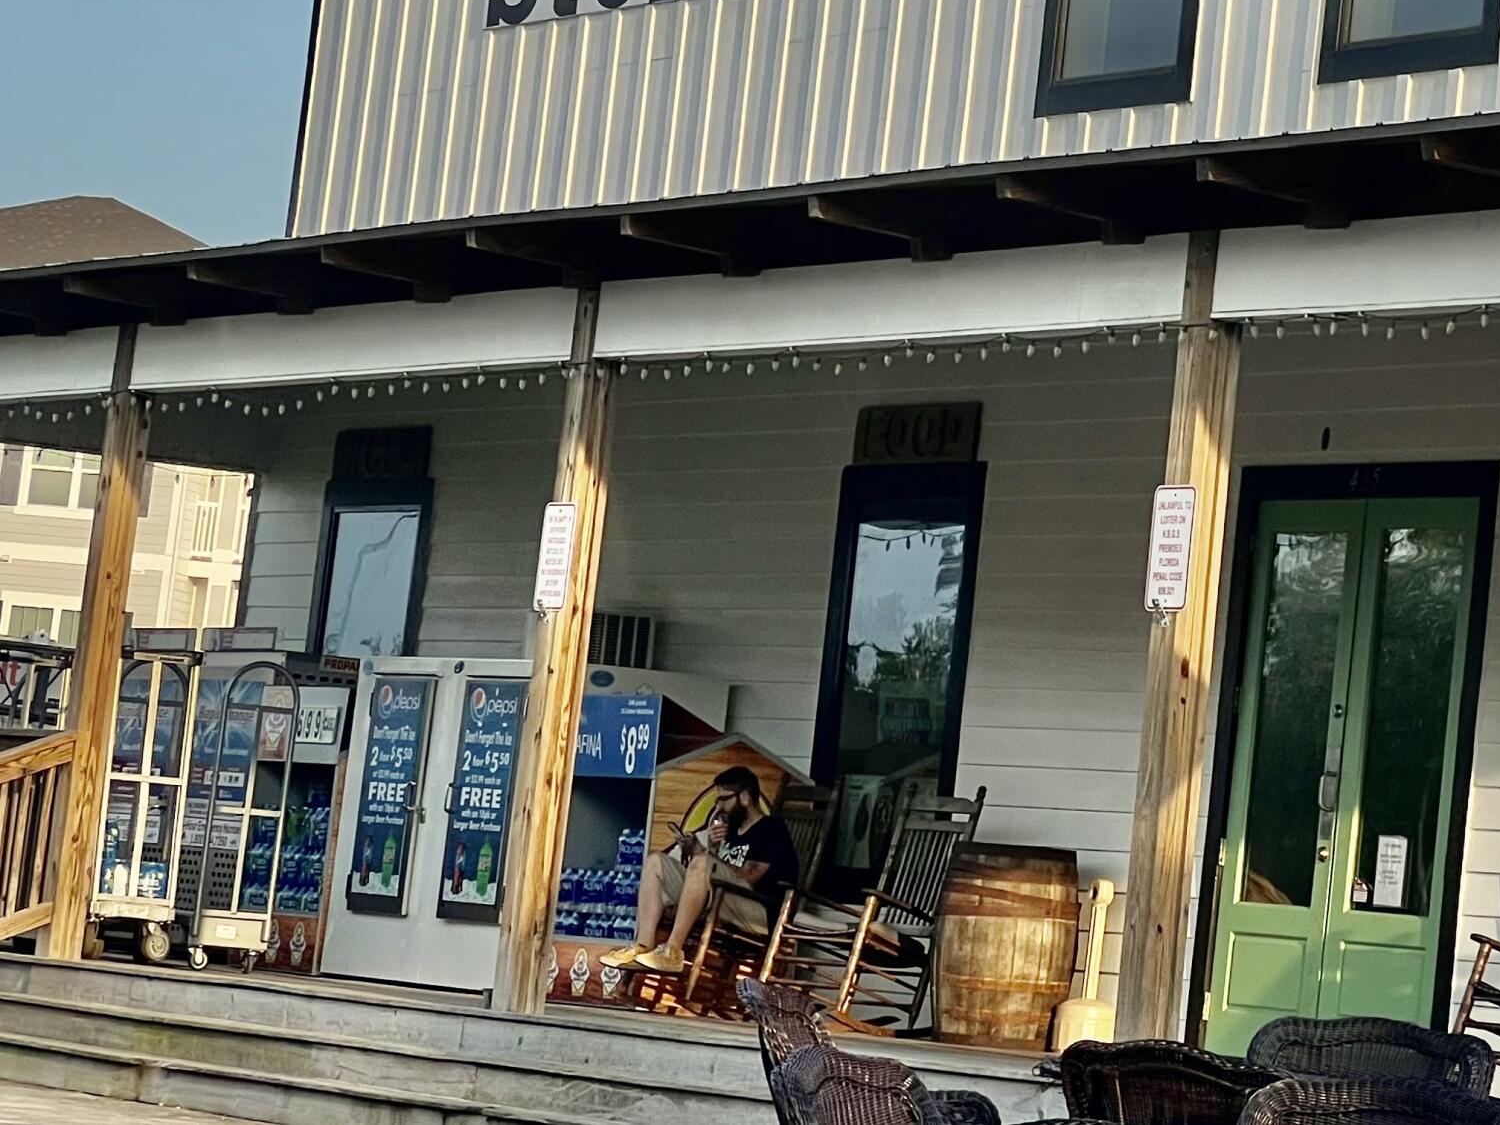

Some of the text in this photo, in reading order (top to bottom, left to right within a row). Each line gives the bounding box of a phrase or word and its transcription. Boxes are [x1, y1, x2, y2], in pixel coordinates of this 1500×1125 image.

[370, 746, 379, 767] 2
[462, 750, 471, 771] 2
[368, 781, 405, 802] FREE
[460, 786, 503, 809] FREE
